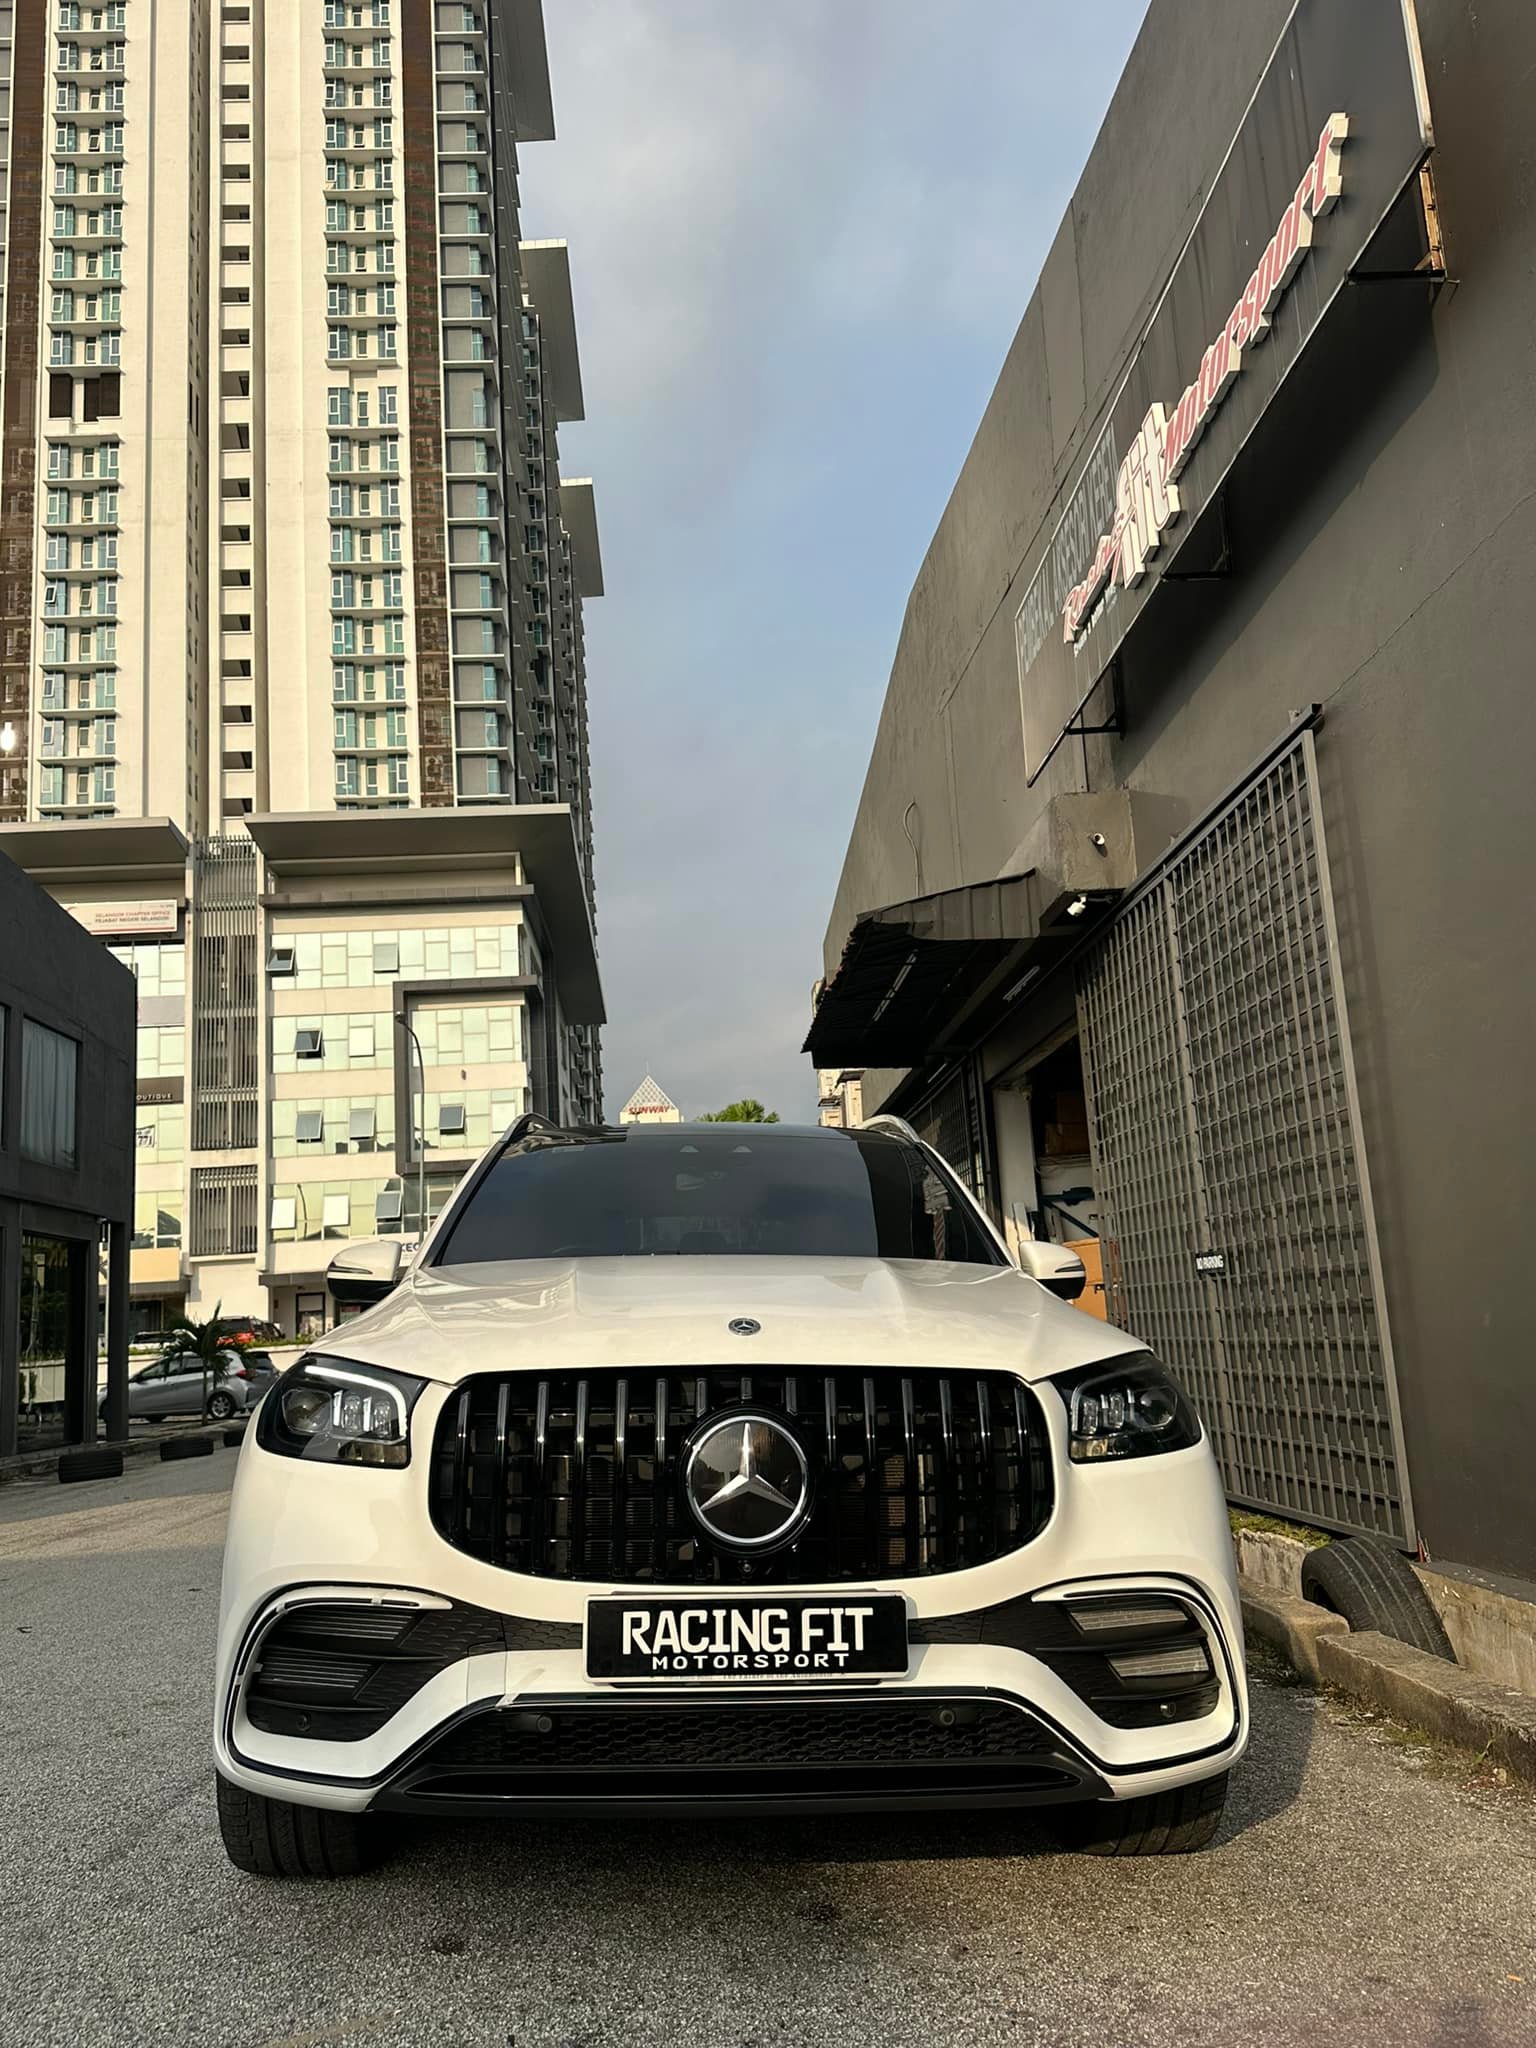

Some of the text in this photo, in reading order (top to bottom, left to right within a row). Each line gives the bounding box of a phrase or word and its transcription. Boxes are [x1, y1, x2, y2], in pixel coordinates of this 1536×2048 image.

[628, 1105, 669, 1115] SUNWAY
[622, 1607, 874, 1655] RACING FIT
[652, 1653, 850, 1670] MOTORSPORT
